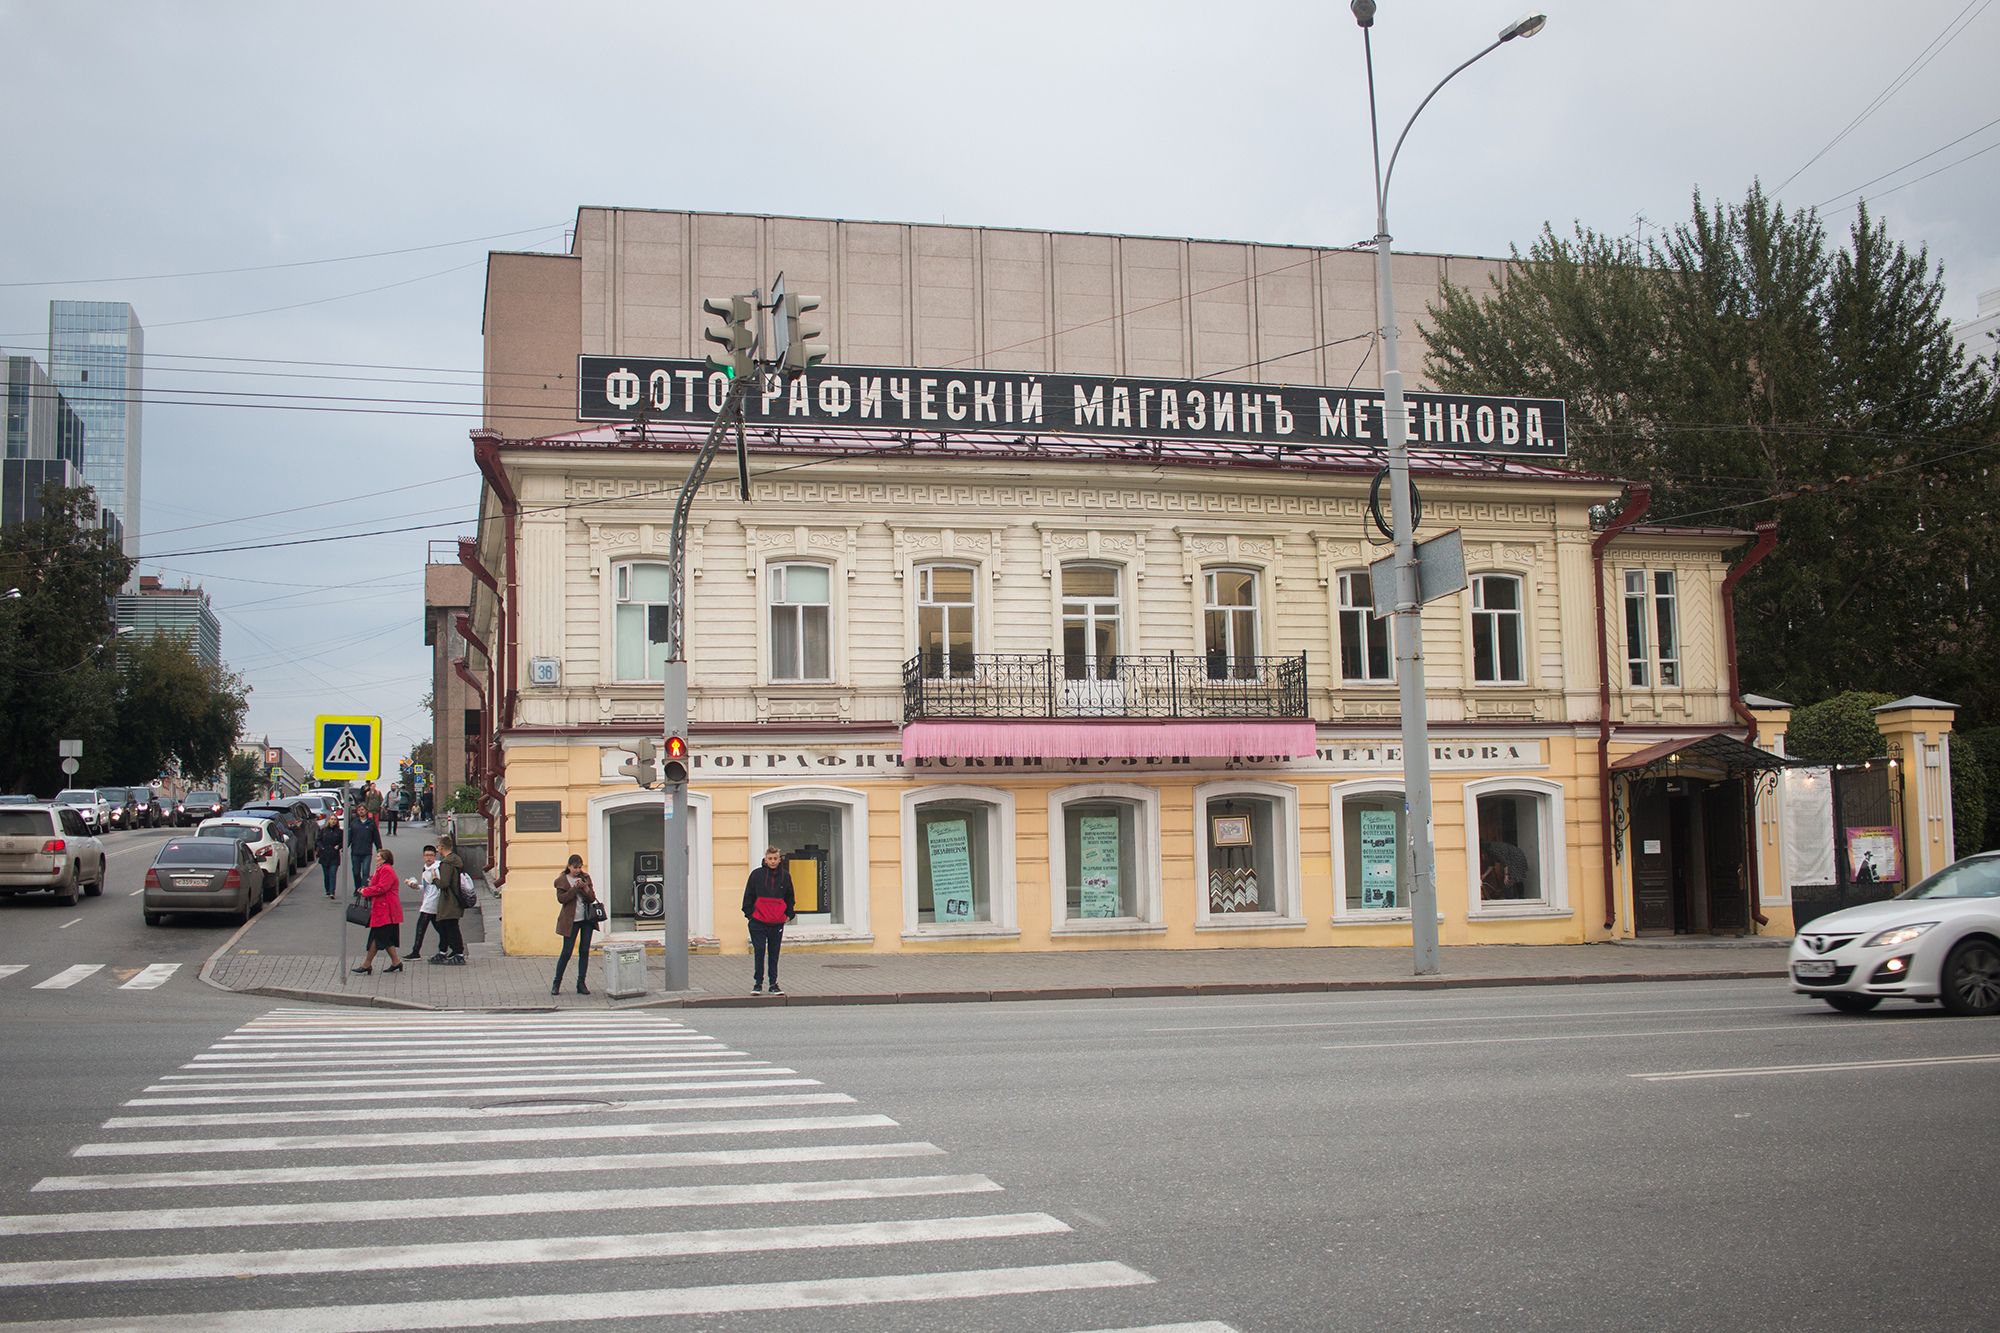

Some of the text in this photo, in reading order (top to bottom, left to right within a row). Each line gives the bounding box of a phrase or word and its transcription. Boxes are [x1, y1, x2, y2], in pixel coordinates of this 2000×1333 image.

[605, 367, 1043, 424] ФОТОРАФИЧЕСКІЙ
[1073, 384, 1294, 434] МАГАЗИНЪ
[538, 665, 553, 680] 36
[1316, 746, 1520, 762] МЕТЕКОВА
